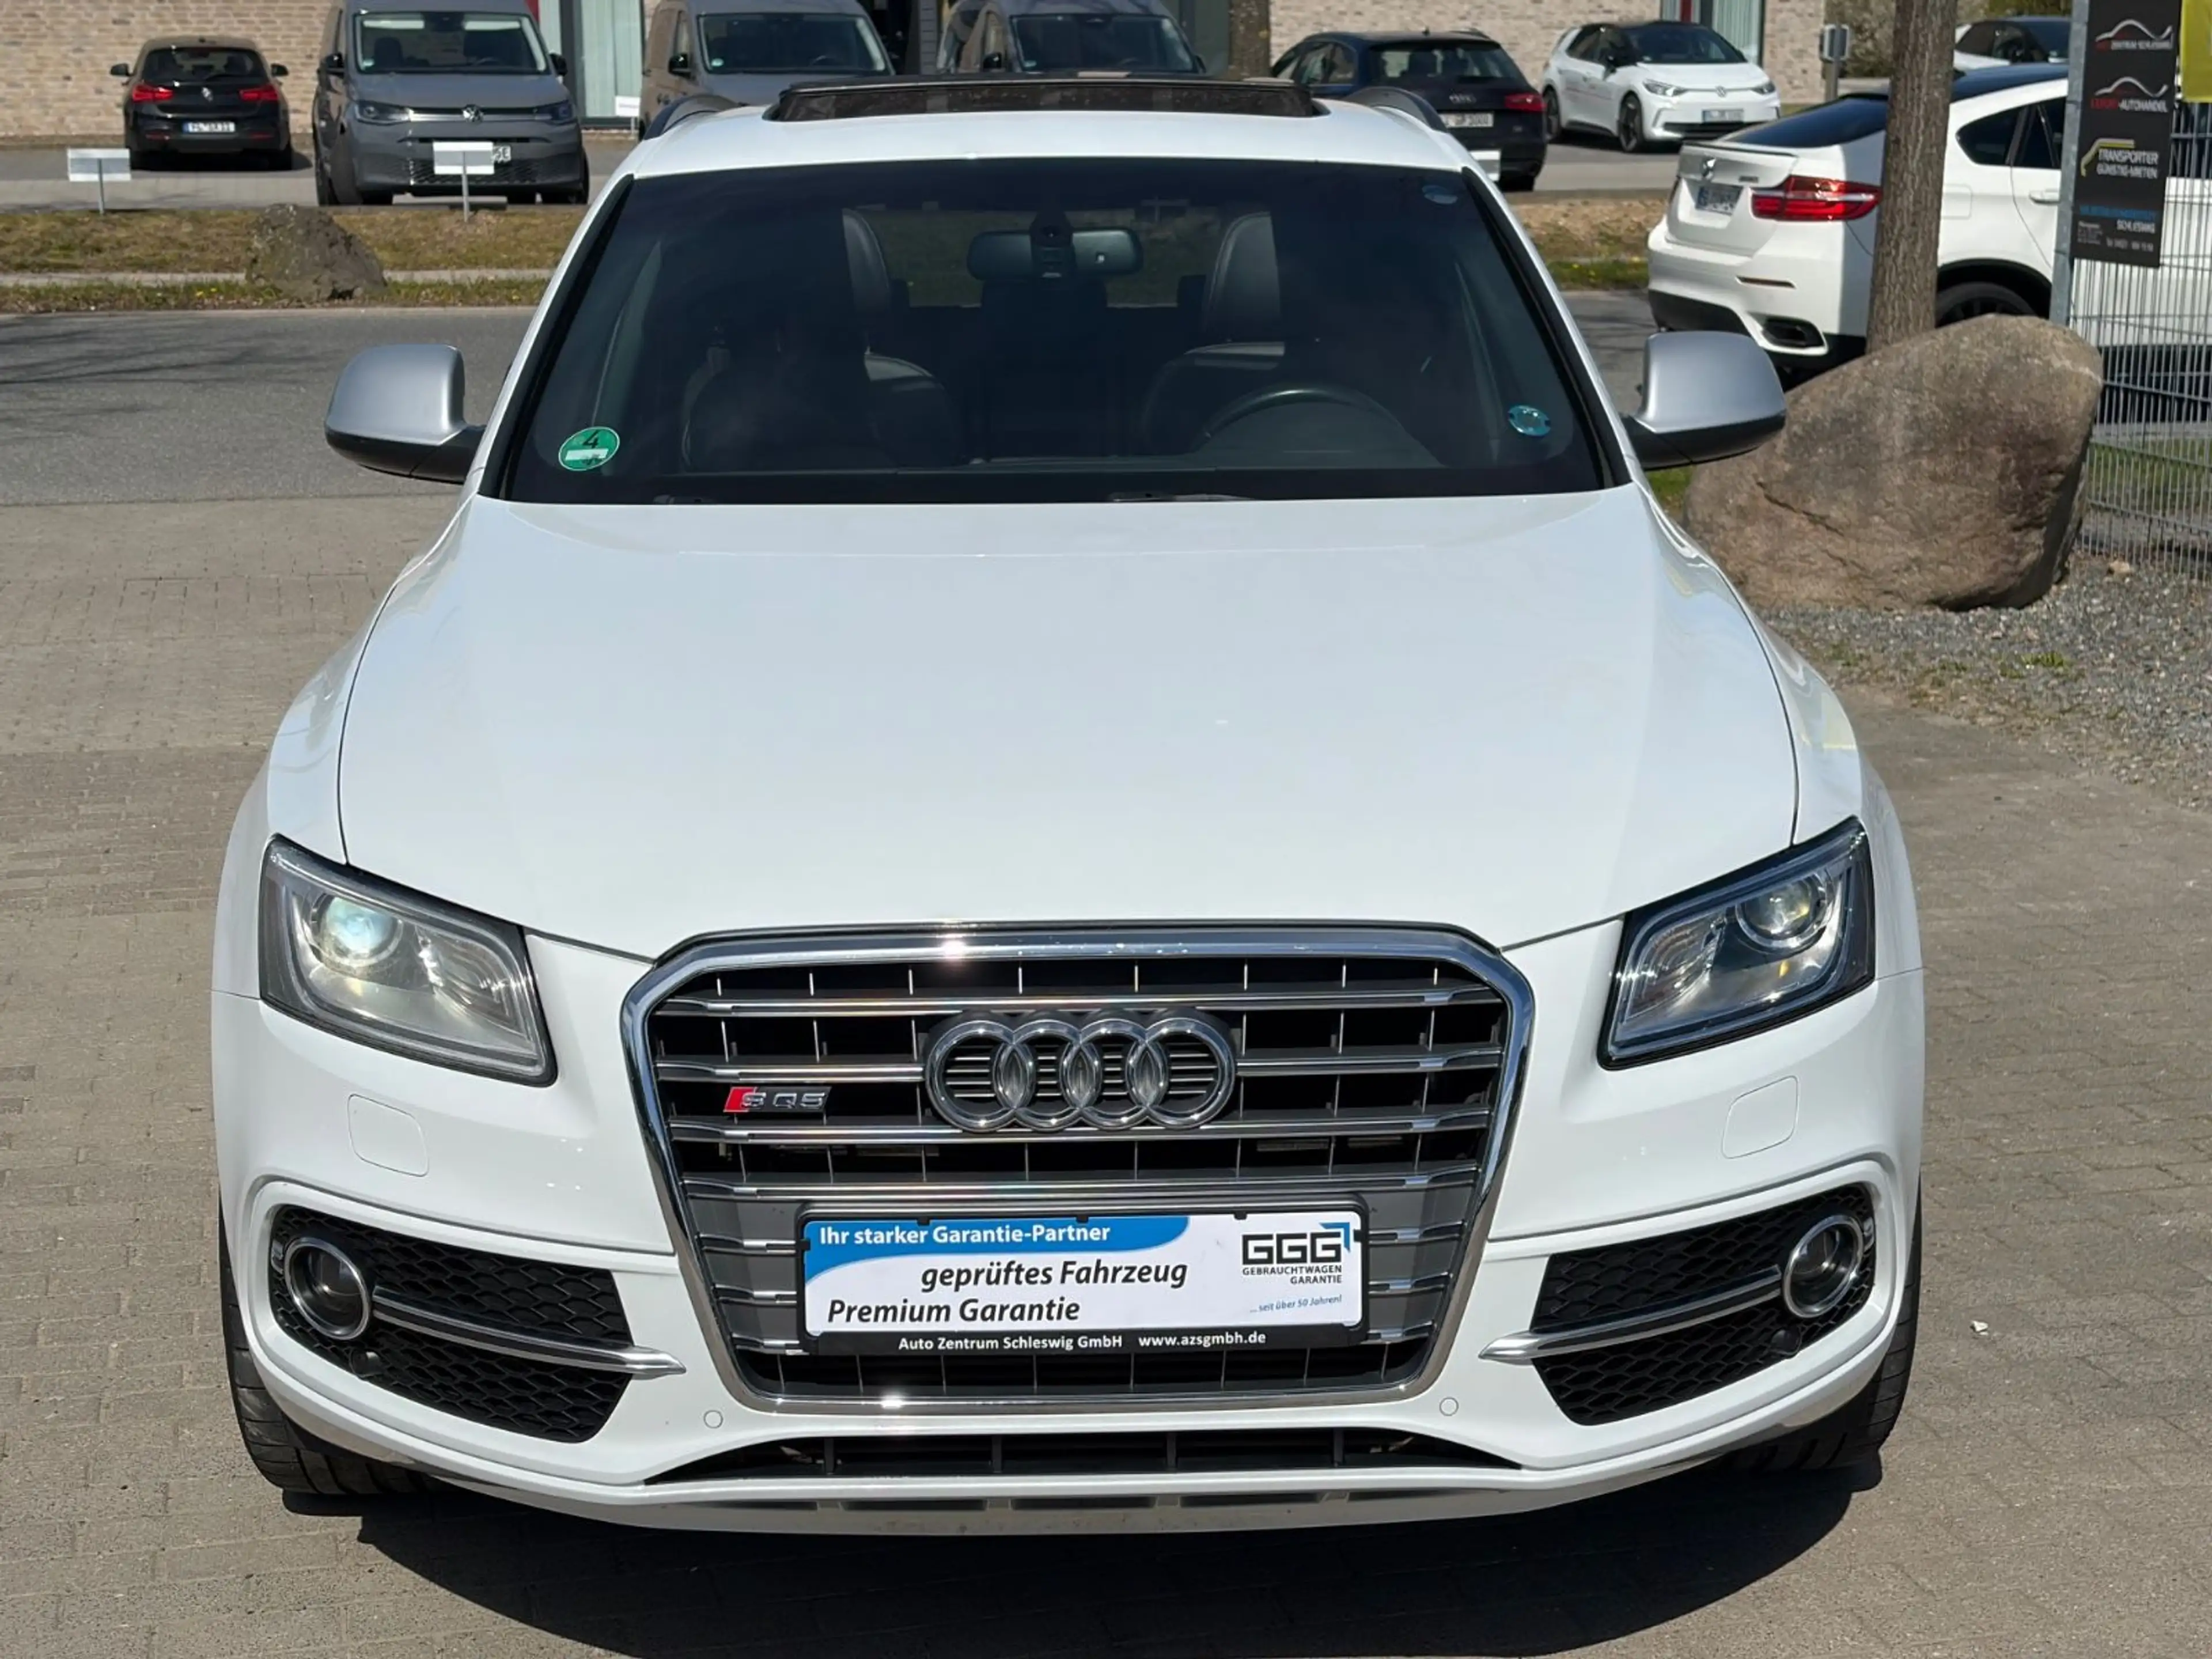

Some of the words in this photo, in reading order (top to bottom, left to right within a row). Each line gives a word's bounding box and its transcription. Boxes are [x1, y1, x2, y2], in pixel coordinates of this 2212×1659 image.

[2099, 149, 2159, 165] TRANSPORTER
[582, 430, 601, 449] 4
[820, 1226, 849, 1244] Ihr
[854, 1226, 926, 1244] starker
[932, 1224, 1111, 1243] Garantie-Partner
[1242, 1232, 1342, 1265] GGG
[921, 1260, 1053, 1293] geprüftes
[1060, 1259, 1188, 1289] Fahrzeug
[1242, 1264, 1342, 1276] GEBRAUCHTWAGEN
[1290, 1274, 1342, 1285] GARANTIE
[828, 1298, 951, 1323] Premium
[959, 1296, 1081, 1322] Garantie
[1275, 1300, 1296, 1310] über
[1297, 1298, 1309, 1308] 50
[1309, 1294, 1343, 1306] Jahren!
[898, 1337, 934, 1350] Auto
[937, 1336, 999, 1350] Zentrum
[1003, 1335, 1074, 1351] Schleswig
[1077, 1335, 1123, 1349] GmbH
[1138, 1331, 1267, 1348] www.azsgmbh.de
